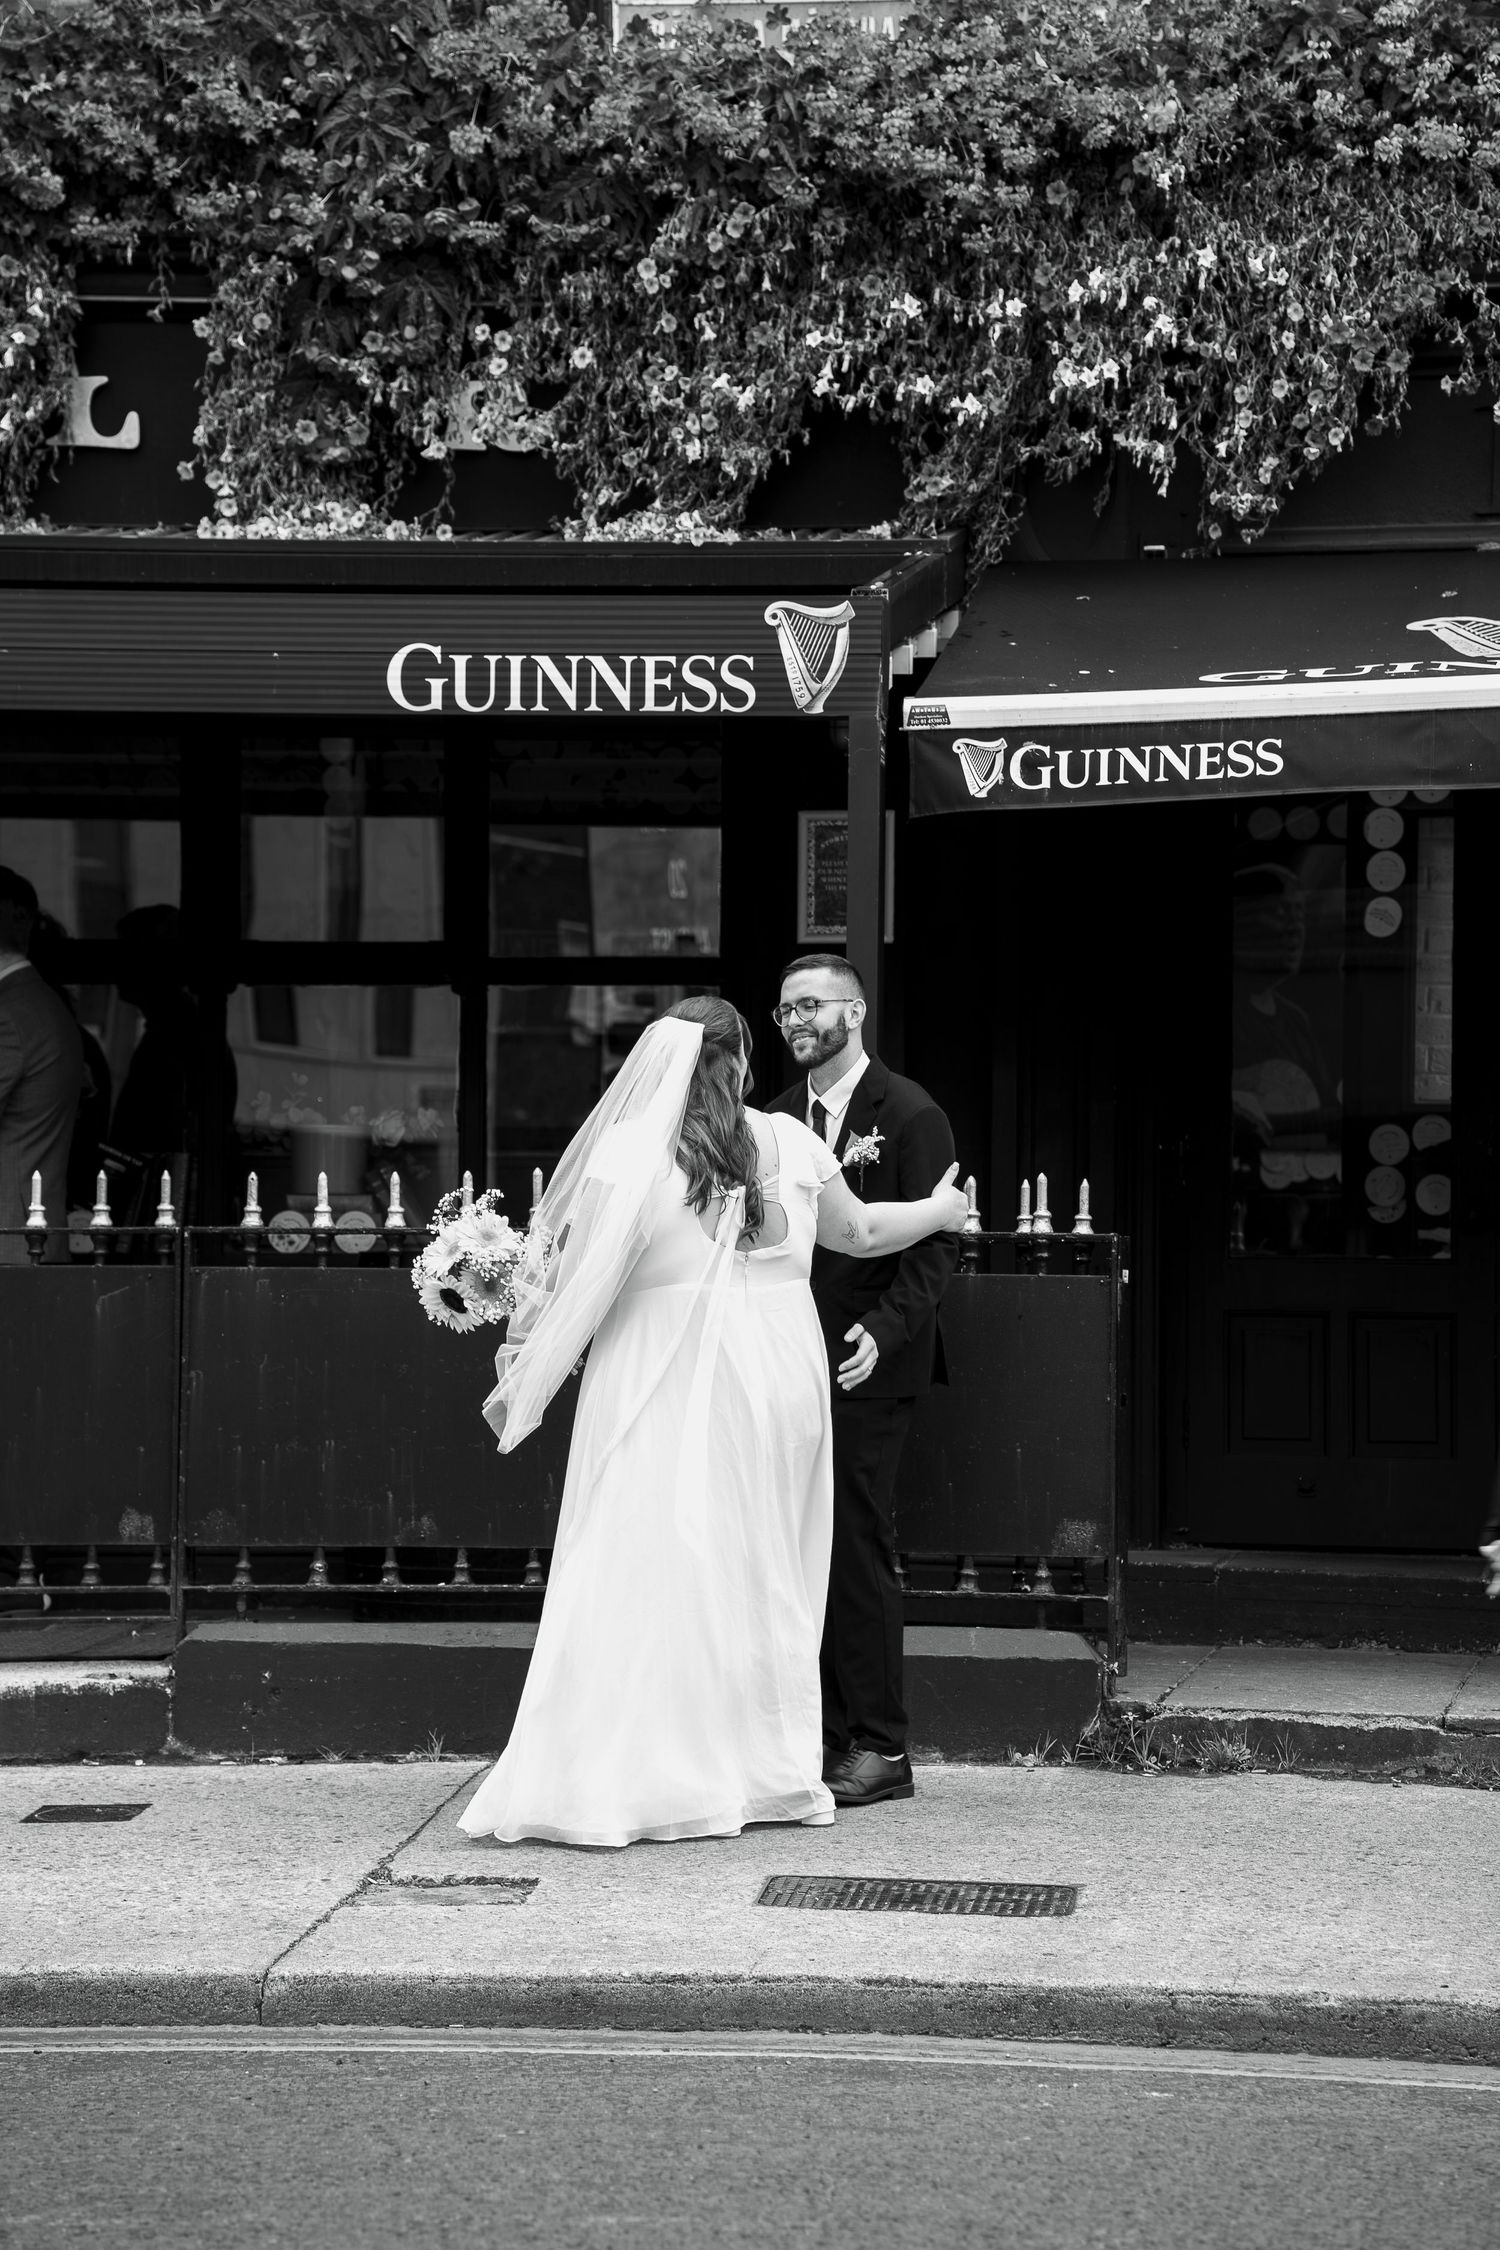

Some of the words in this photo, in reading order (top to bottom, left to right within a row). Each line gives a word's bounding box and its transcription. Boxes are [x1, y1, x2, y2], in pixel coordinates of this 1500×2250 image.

[387, 643, 756, 713] GUINNESS
[791, 676, 806, 699] 1759
[1009, 738, 1284, 790] GUINNESS
